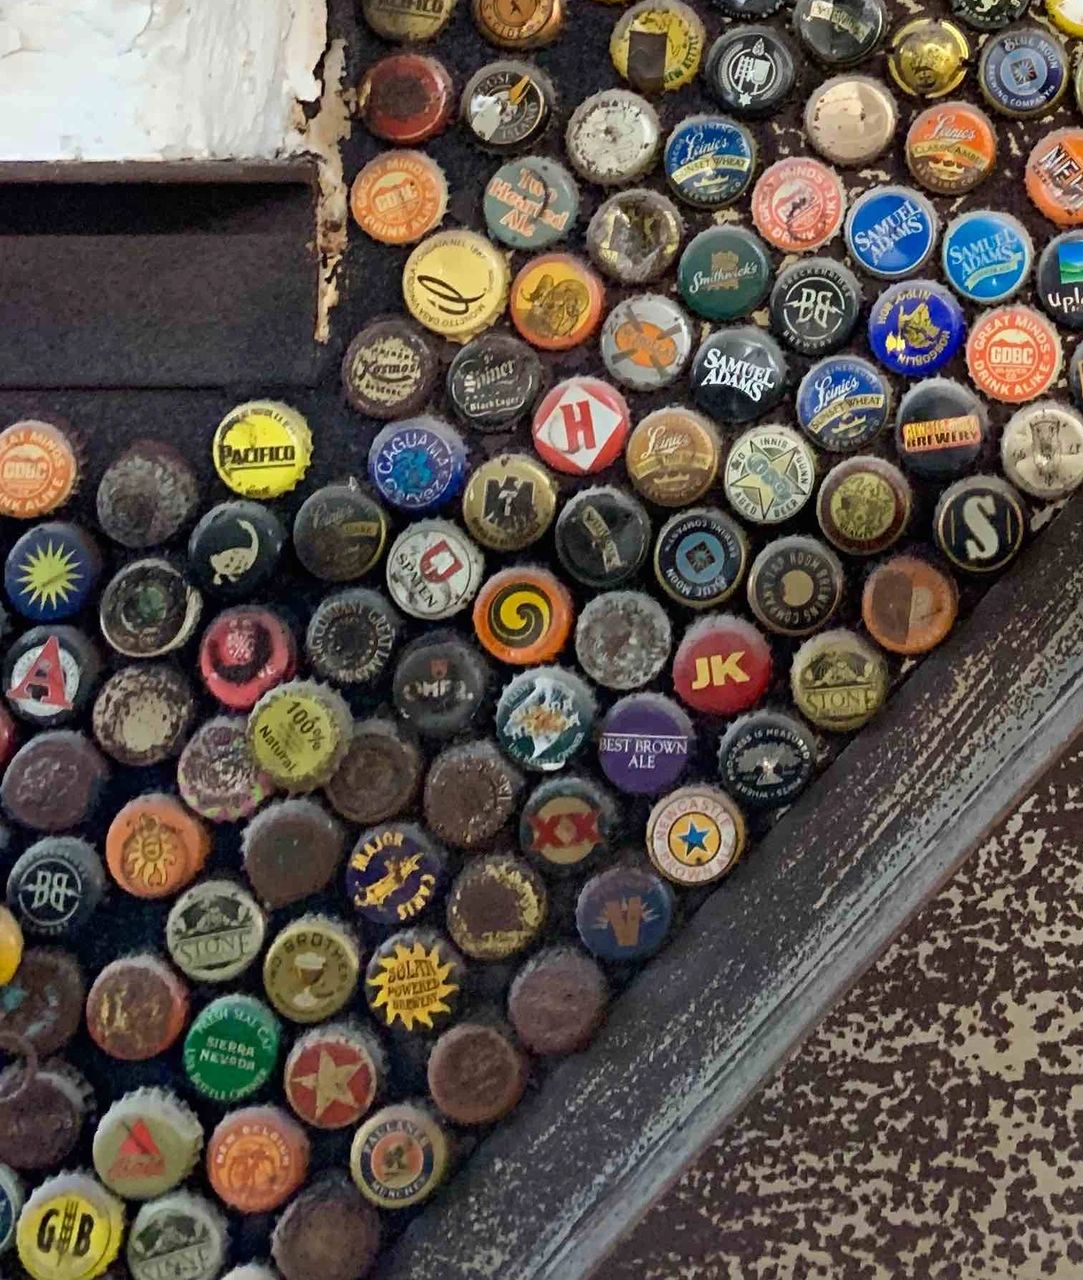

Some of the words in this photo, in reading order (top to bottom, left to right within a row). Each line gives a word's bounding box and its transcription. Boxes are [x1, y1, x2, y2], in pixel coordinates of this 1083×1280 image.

[500, 208, 536, 238] Ale
[855, 200, 921, 252] SAMUEL
[870, 216, 923, 264] ADAMS
[950, 228, 1018, 265] SAMUEL
[689, 261, 757, 294] Smithwick's
[961, 245, 1014, 277] ADAMS
[783, 330, 834, 349] BREWERY
[974, 315, 1011, 350] GREAT
[1014, 314, 1051, 353] MINDS
[704, 347, 777, 389] SAMUEL
[990, 346, 1033, 365] GDBC
[701, 370, 764, 404] ADAMS
[973, 361, 1011, 396] DRINK
[1014, 363, 1051, 397] ALIKE
[470, 399, 494, 412] Black
[495, 396, 520, 409] Lager
[848, 396, 882, 408] WHEAT
[560, 400, 597, 453] H
[219, 445, 296, 466] PACIFICO
[760, 437, 788, 450] INNIS
[796, 455, 811, 485] GUNN
[735, 492, 757, 516] AGED
[773, 500, 800, 518] BEER
[962, 494, 1000, 561] S
[397, 553, 437, 609] SPATEN
[5, 636, 74, 710] A
[691, 650, 751, 691] JK
[288, 700, 325, 753] 100%
[258, 724, 297, 772] Natural
[601, 738, 633, 754] BEST
[635, 739, 689, 755] BROWN
[628, 755, 657, 770] ALE
[180, 936, 251, 966] STONE
[387, 959, 437, 983] SOLAR
[387, 979, 441, 999] POWERED
[200, 1049, 256, 1071] NEVADA
[206, 1036, 255, 1058] SIERRA
[215, 1133, 236, 1164] NEW
[242, 1125, 290, 1166] BELGIUM
